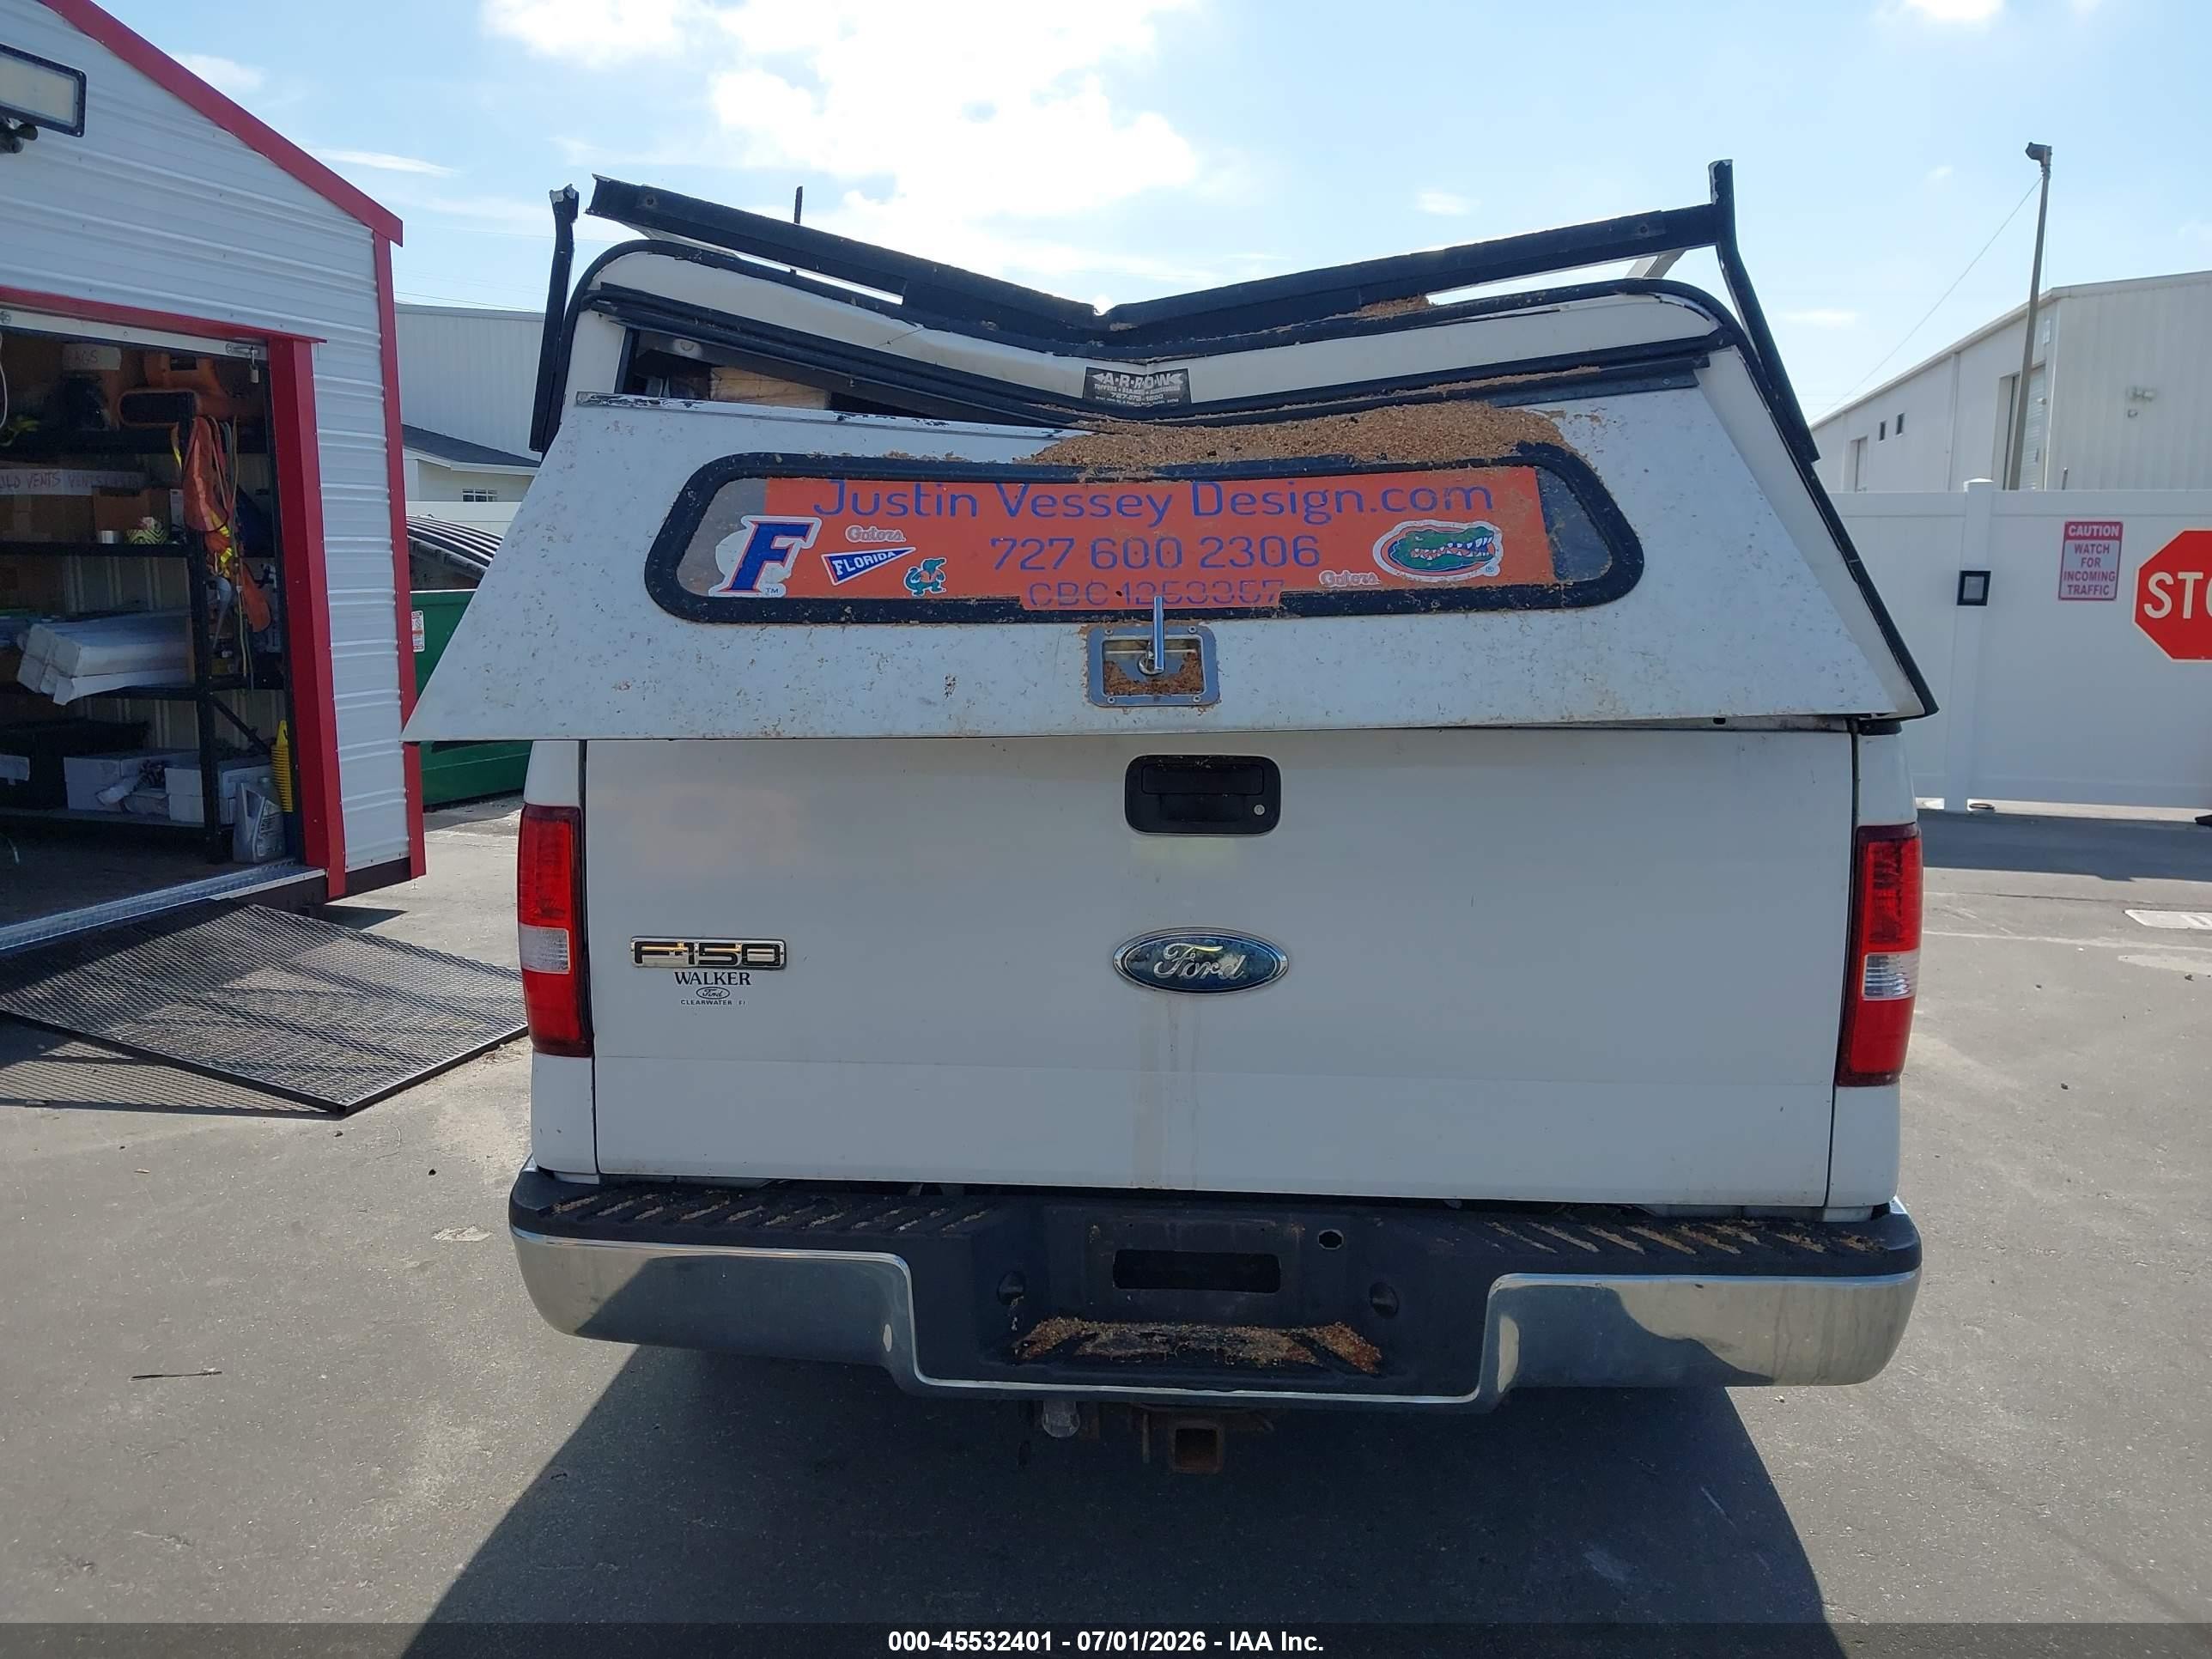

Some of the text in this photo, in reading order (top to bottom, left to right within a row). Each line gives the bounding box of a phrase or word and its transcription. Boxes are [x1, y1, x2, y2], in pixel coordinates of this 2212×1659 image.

[27, 471, 62, 489] VENTS
[813, 479, 1493, 528] Justin Vessey Design.com
[2068, 525, 2120, 537] CAUTION
[718, 520, 814, 592] F
[989, 535, 1321, 571] 727 600 2306
[2074, 543, 2111, 555] WATCH
[832, 550, 897, 576] FLORIDA
[2081, 556, 2101, 568] FOR
[2063, 570, 2116, 582] INCOMING
[2067, 584, 2110, 596] TRAFFIC
[2143, 571, 2212, 619] ST
[1153, 942, 1246, 981] Ford
[674, 971, 752, 986] WALKER
[700, 988, 726, 998] Ford
